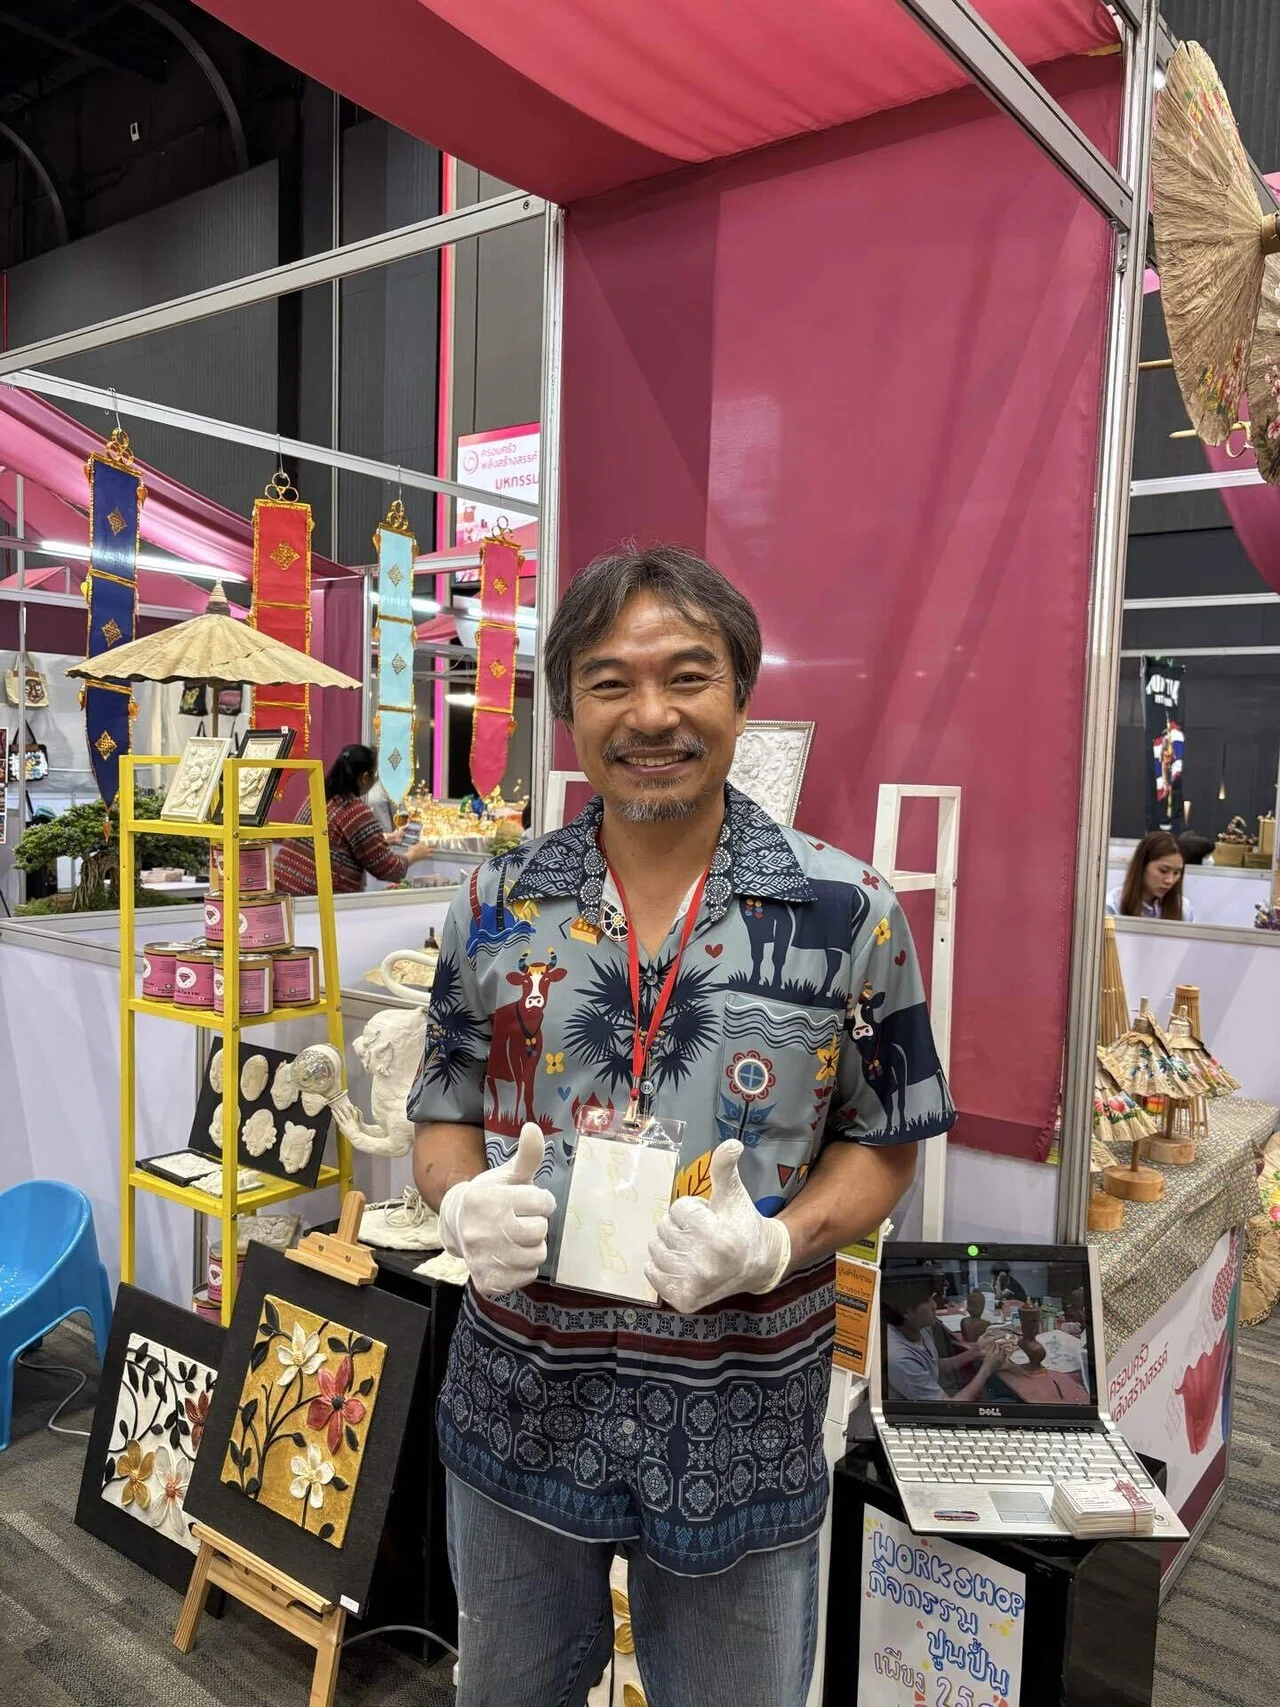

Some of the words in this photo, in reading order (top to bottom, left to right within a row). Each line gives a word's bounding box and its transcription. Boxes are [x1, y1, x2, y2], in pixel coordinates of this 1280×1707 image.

[481, 443, 517, 457] ครอบครัว
[482, 451, 538, 469] พลังสร้างสรรค์
[1110, 1343, 1149, 1401] ครอบครัว
[979, 1407, 1002, 1416] DELL
[868, 1560, 979, 1635] กิจกรรม
[874, 1647, 926, 1694] เพียง
[936, 1676, 995, 1707] 25
[926, 1628, 1011, 1696] ปูนปั้น
